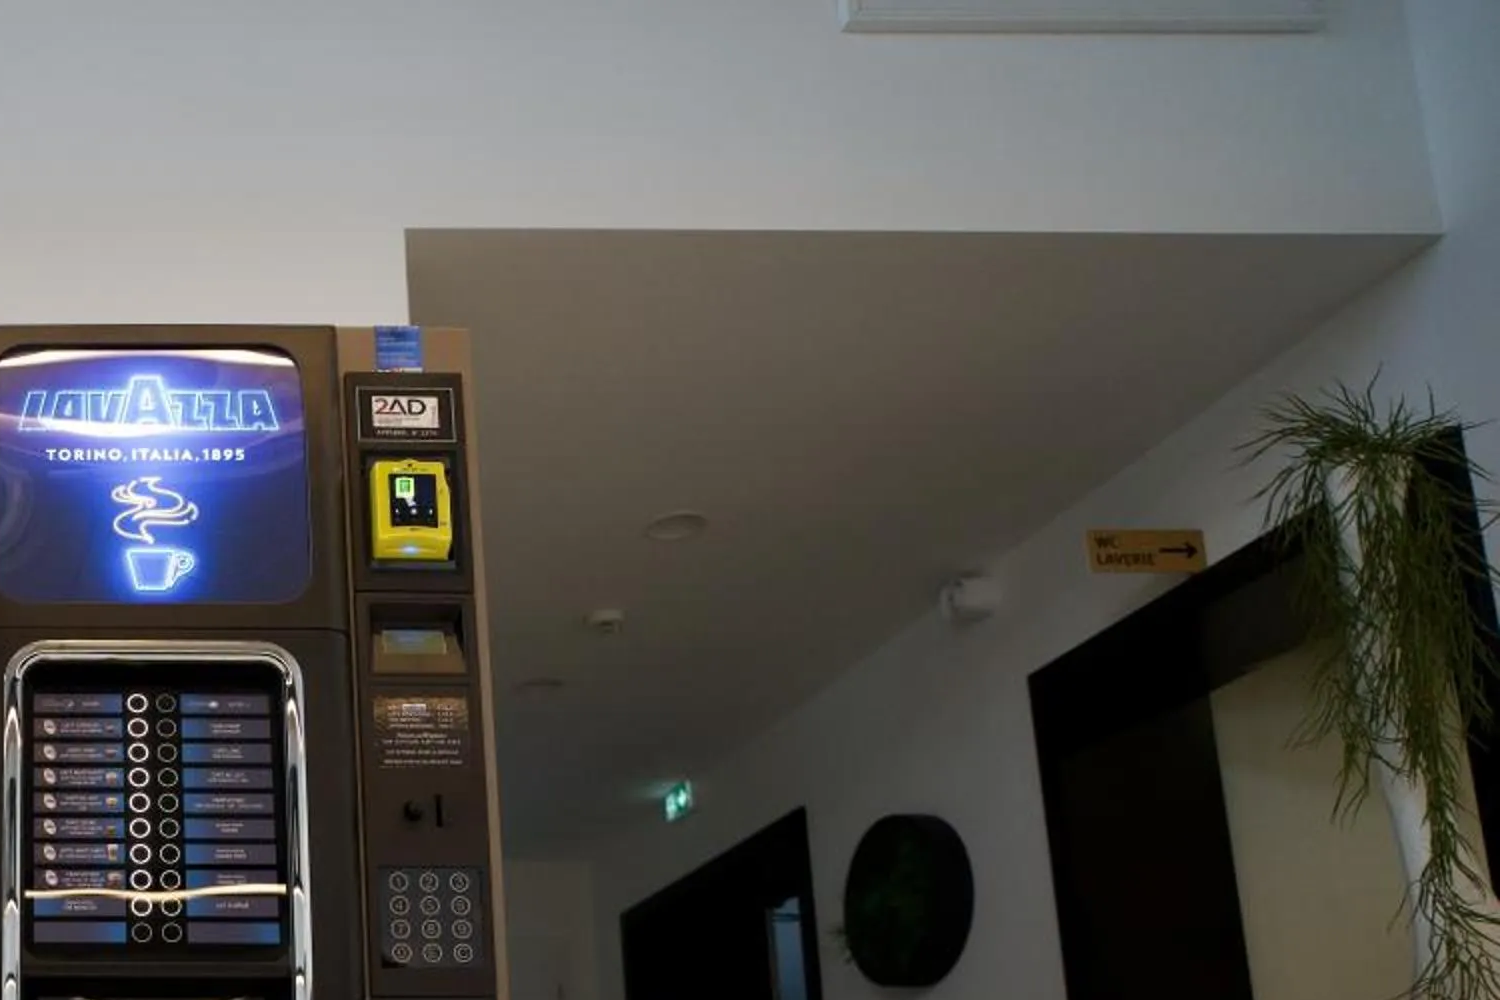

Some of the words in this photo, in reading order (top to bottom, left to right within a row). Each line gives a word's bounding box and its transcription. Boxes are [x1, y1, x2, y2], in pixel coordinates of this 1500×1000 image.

[17, 373, 280, 432] LAVAZZA
[373, 398, 427, 416] 2AD
[202, 447, 246, 462] 1895
